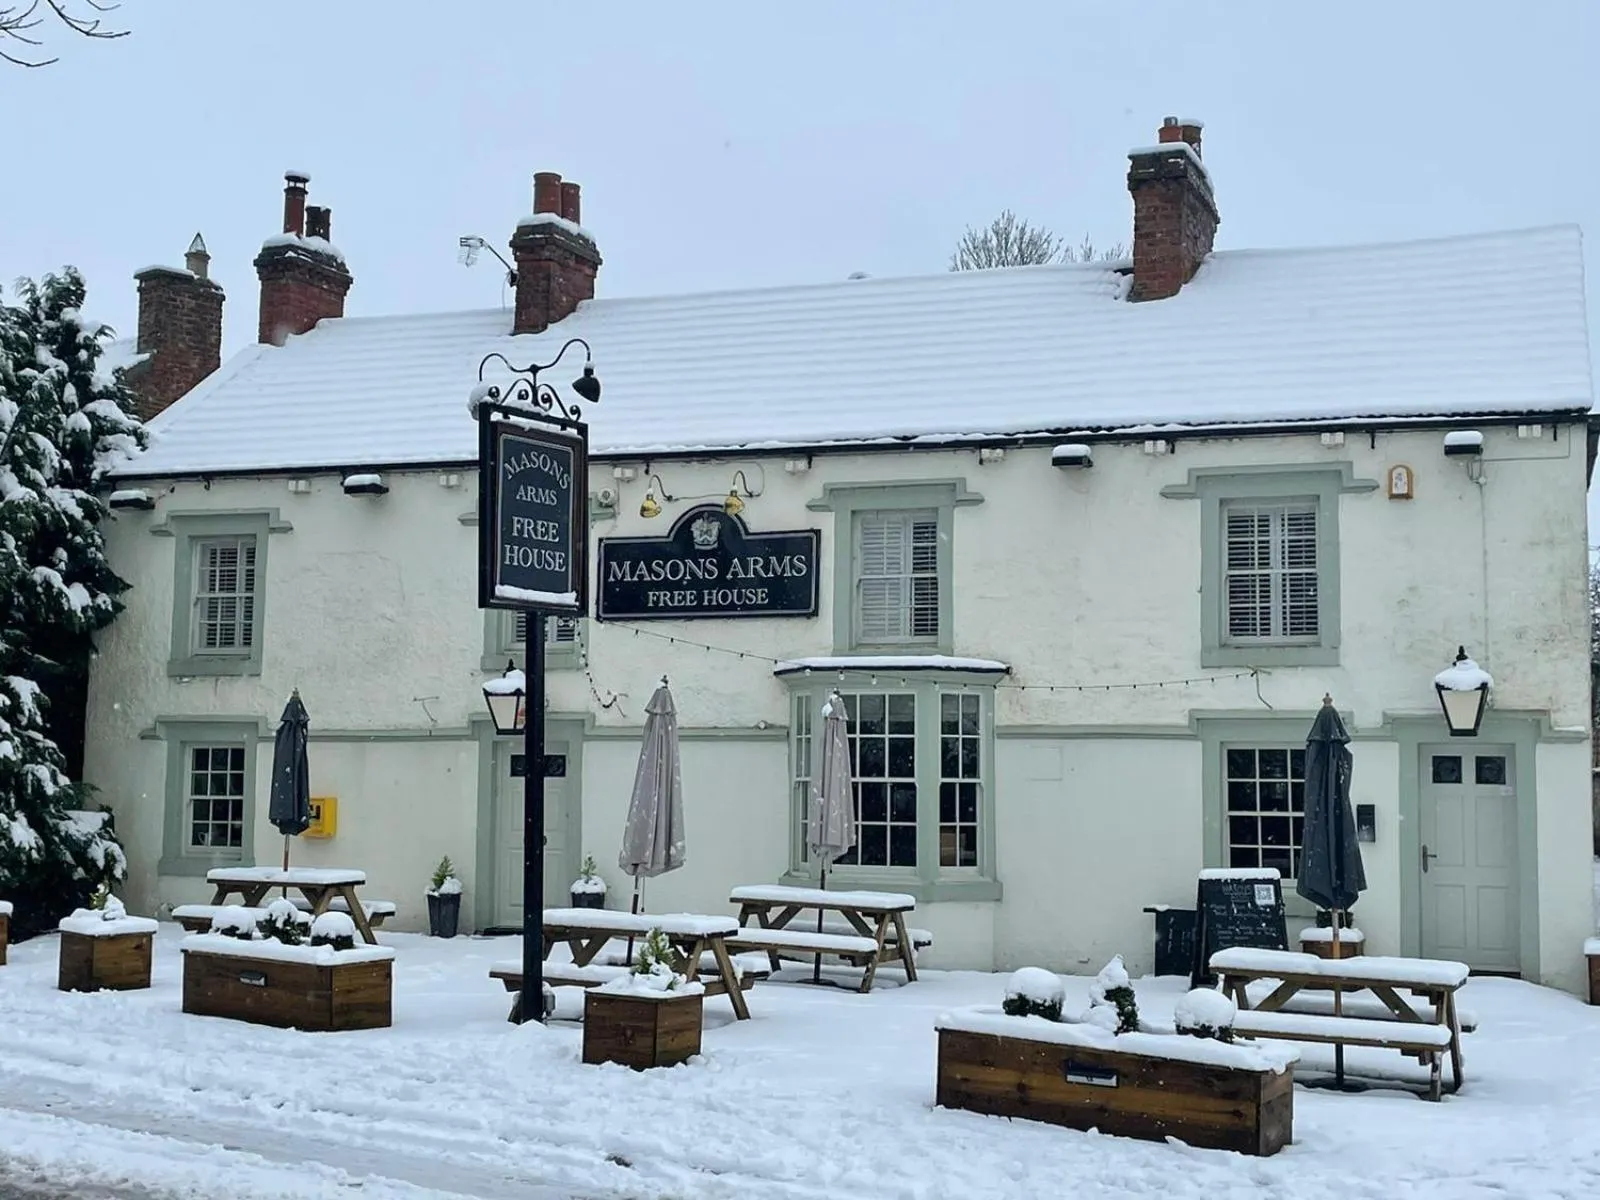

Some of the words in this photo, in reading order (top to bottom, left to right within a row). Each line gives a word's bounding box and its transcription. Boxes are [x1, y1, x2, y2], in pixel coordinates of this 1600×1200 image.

[504, 451, 570, 490] MASONS
[516, 485, 558, 506] ARMS
[512, 516, 559, 542] FREE
[504, 545, 566, 572] HOUSE
[608, 558, 719, 582] MASONS
[726, 555, 808, 578] ARMS
[648, 590, 697, 607] FREE
[702, 588, 769, 606] HOUSE
